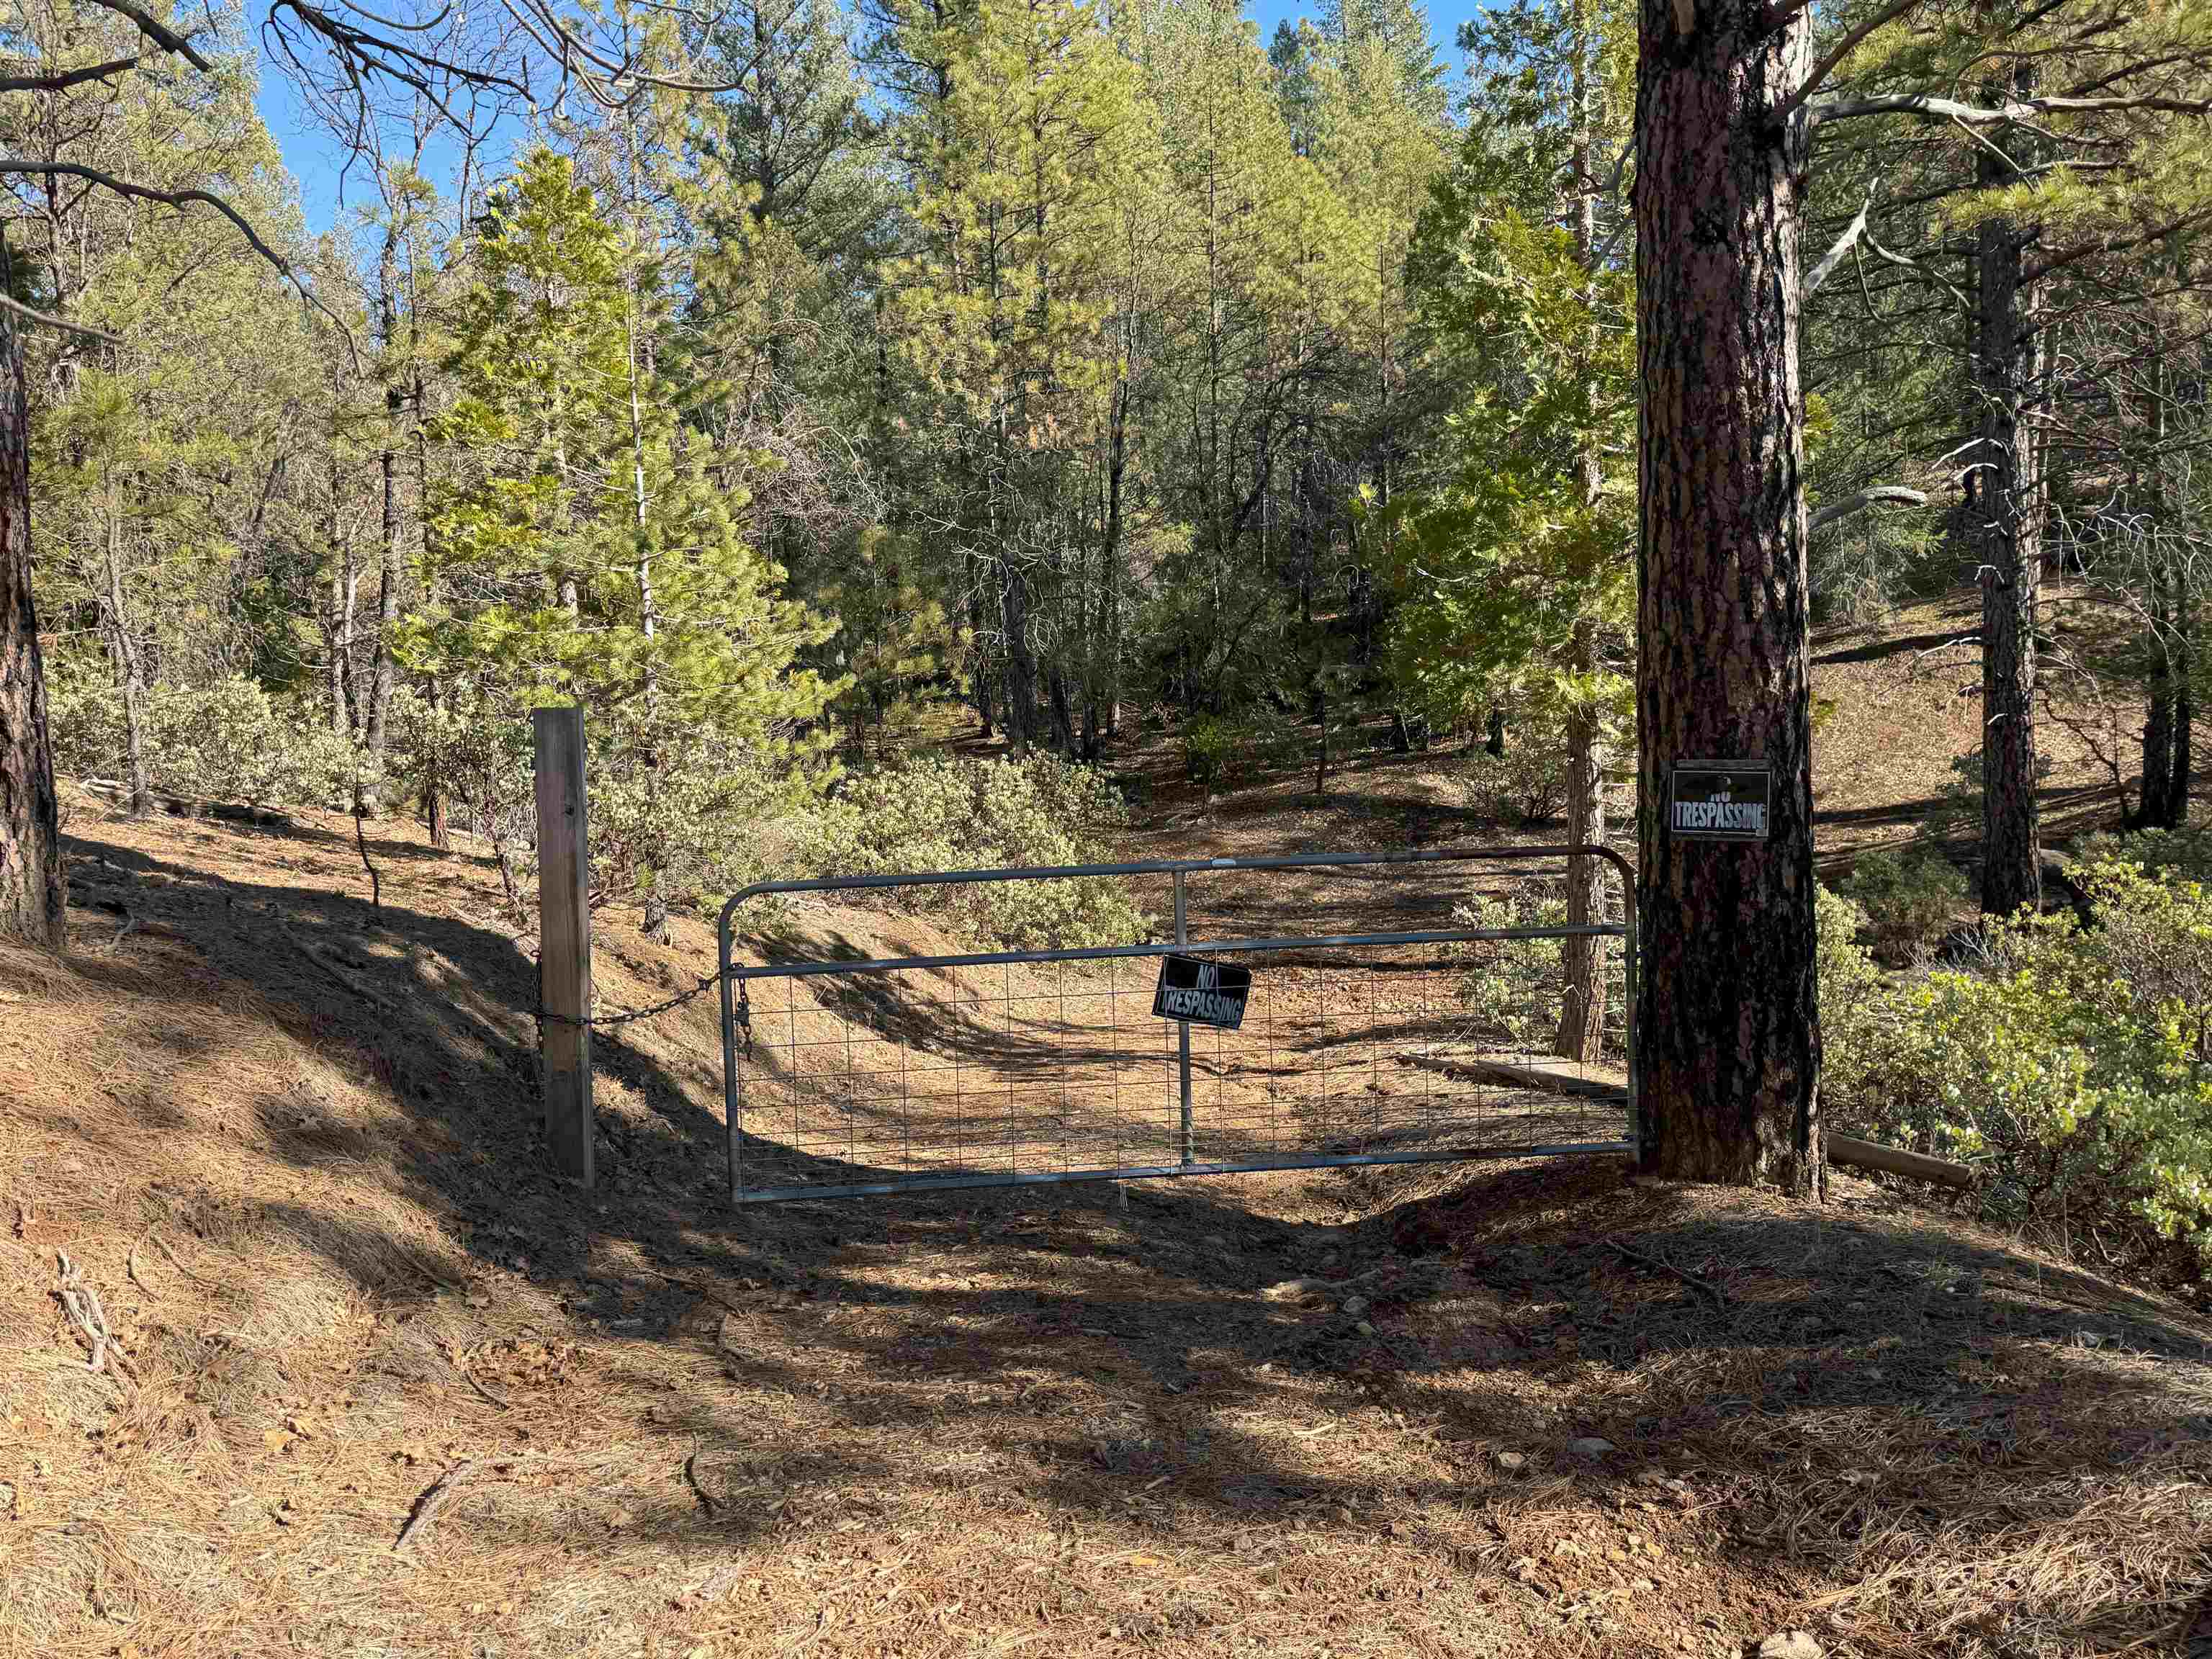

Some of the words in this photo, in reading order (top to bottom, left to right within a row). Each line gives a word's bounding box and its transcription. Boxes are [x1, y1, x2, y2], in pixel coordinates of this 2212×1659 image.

[1675, 802, 1765, 830] TRESPASSING
[1197, 964, 1216, 990] NO
[1161, 984, 1242, 1021] TRESPASSING
